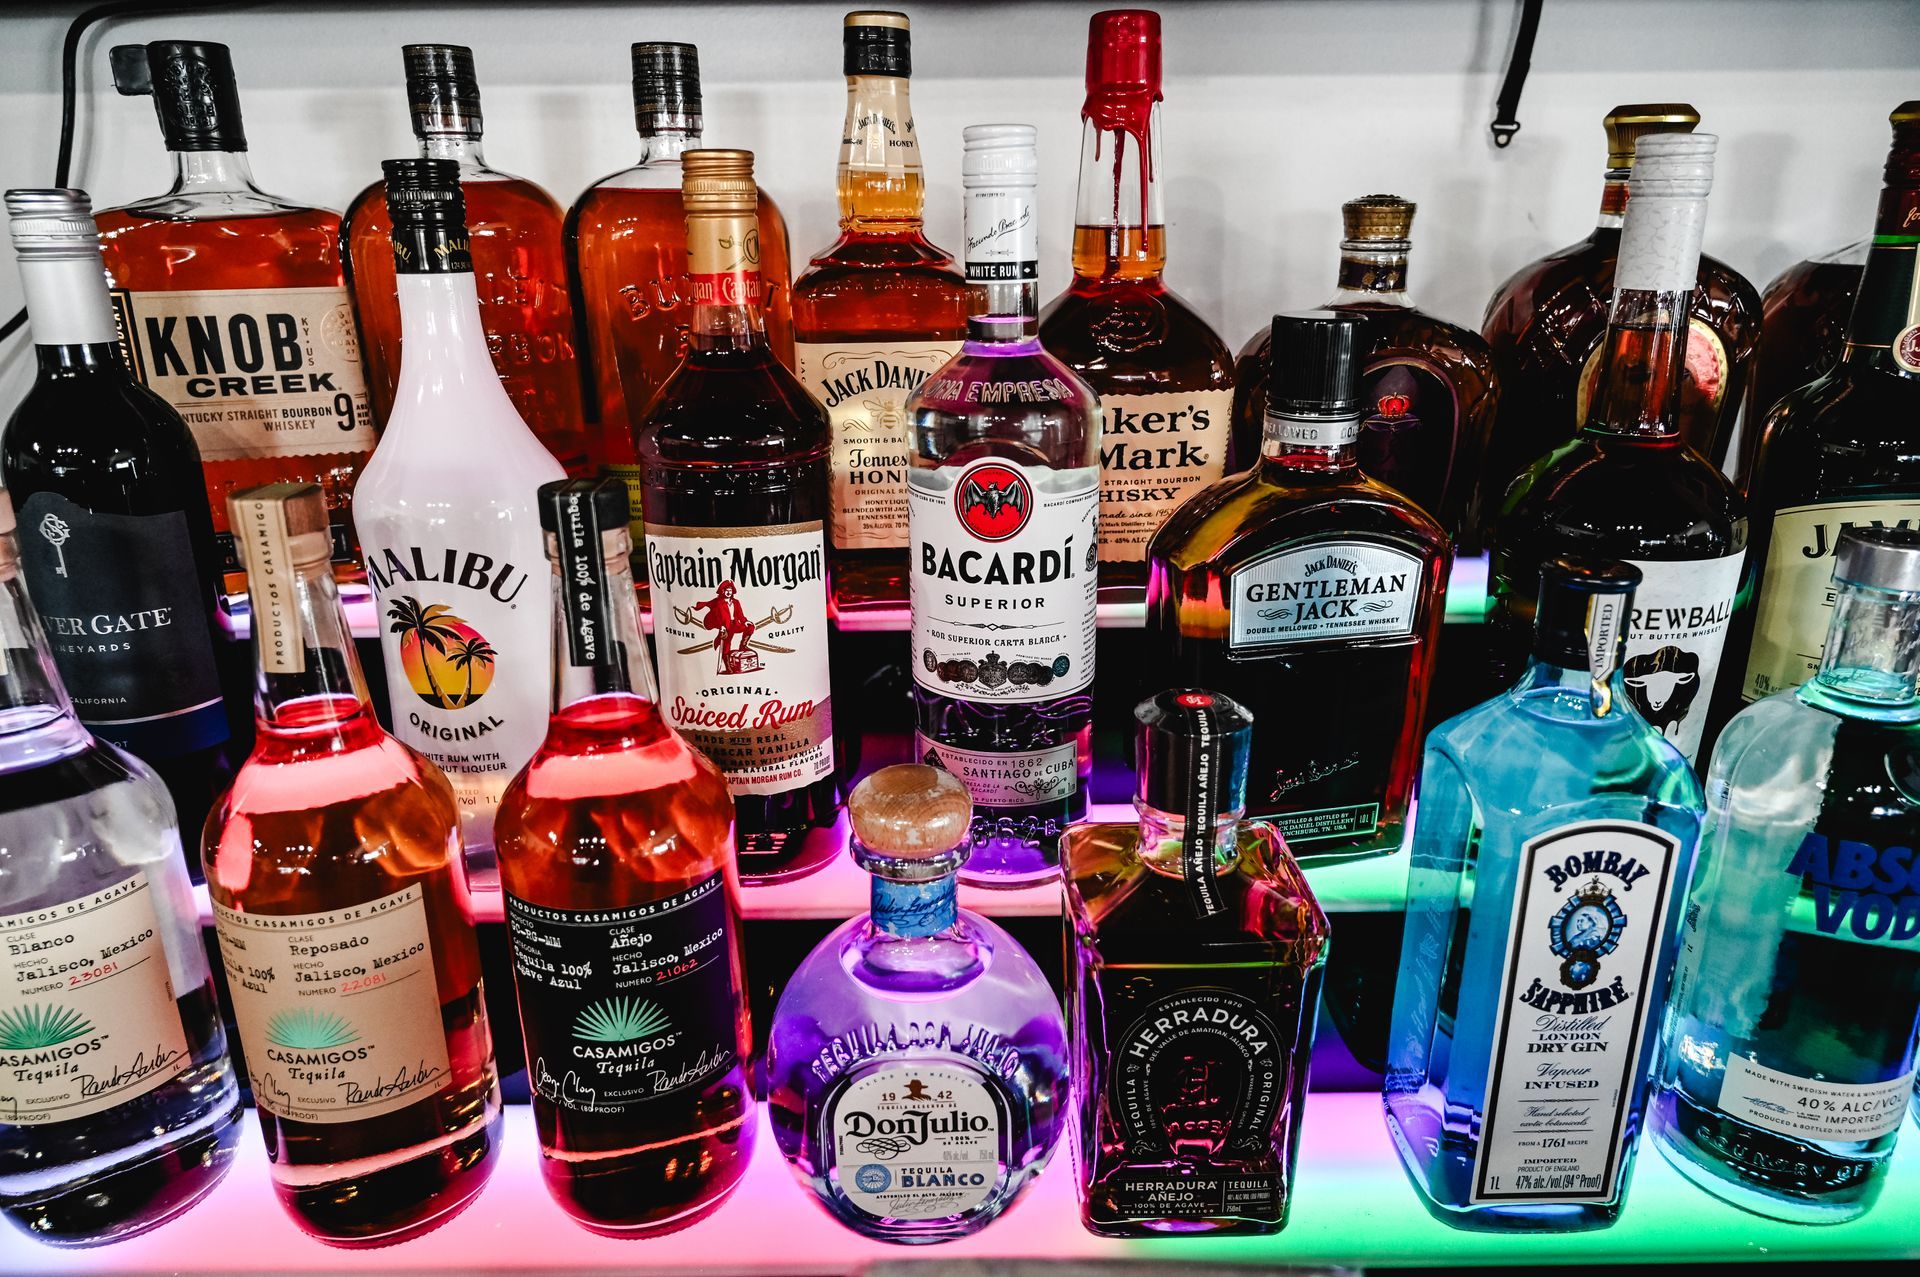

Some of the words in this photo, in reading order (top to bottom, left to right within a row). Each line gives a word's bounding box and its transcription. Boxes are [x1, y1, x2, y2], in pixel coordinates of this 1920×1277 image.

[889, 139, 914, 148] HONEY
[969, 265, 996, 278] WHITE
[999, 264, 1020, 277] RUM
[145, 313, 303, 376] KNOB
[186, 372, 337, 398] CREEK
[821, 367, 873, 408] JACK
[875, 361, 931, 392] DANI
[965, 377, 1074, 403] EMPRESA
[181, 411, 224, 424] NTUCKY
[227, 409, 278, 421] STRAIGHT
[282, 406, 332, 419] BOURBON
[334, 393, 355, 432] 9
[1102, 404, 1210, 434] ker's
[263, 419, 316, 432] WHISKEY
[843, 437, 881, 445] SMOOTH
[849, 448, 907, 468] Tennes
[1100, 440, 1207, 471] Mark
[1104, 478, 1152, 487] STRAIGHT
[1156, 475, 1201, 485] BOURBON
[648, 541, 722, 592] Captain
[722, 545, 821, 590] Morgan
[922, 534, 1074, 585] BACARDÍ
[1304, 557, 1326, 578] JACK
[368, 546, 528, 604] MALIBU
[575, 555, 596, 586] 100%
[1246, 574, 1407, 603] GENTLEMAN
[579, 592, 592, 611] de
[945, 594, 1045, 610] SUPERIOR
[91, 607, 171, 635] GATE
[1293, 599, 1358, 625] JACK
[1630, 598, 1731, 630] REWBALL
[267, 583, 284, 665] PRODUCTOS
[665, 626, 695, 639] GENUINE
[768, 625, 805, 639] QUALITY
[1246, 626, 1275, 635] DOUBLE
[1278, 623, 1318, 633] MELLOWED
[1325, 619, 1367, 629] TENNESSEE
[1368, 616, 1400, 625] WHISKEY
[1649, 632, 1688, 640] BUTTER
[1692, 625, 1722, 638] WHISKEY
[580, 617, 595, 661] Agave
[947, 633, 991, 646] SUPERIOR
[994, 638, 1025, 647] CARTA
[1028, 634, 1061, 646] BLANCA
[1595, 603, 1613, 668] IMPORTED
[701, 686, 771, 698] ORIGINAL
[671, 695, 749, 729] Spiced
[752, 699, 814, 730] Rum
[409, 711, 504, 741] ORIGINAL
[756, 733, 787, 744] REAL
[758, 737, 810, 755] VANILLA
[447, 753, 470, 763] RUM
[472, 751, 500, 762] WITH
[743, 763, 786, 774] NATURAL
[789, 752, 823, 768] FLAVORS
[941, 751, 994, 766] ESTABLECIDO
[1011, 757, 1042, 769] 1862
[461, 762, 507, 774] LIQUEUR
[963, 766, 1031, 779] SANTIAGO
[1045, 758, 1074, 775] CUBA
[1197, 753, 1210, 788] AÑEJO
[751, 774, 778, 784] MORGAN
[779, 772, 791, 781] RUM
[1197, 791, 1208, 834] TEQUILA
[1193, 838, 1204, 872] AÑEJO
[1544, 850, 1650, 892] BOMBAY
[67, 902, 85, 914] DE
[94, 880, 137, 905] AGAVE
[509, 896, 567, 922] PRODUCTOS
[575, 905, 655, 923] CASAMIGOS
[662, 898, 678, 910] DE
[684, 878, 716, 901] AGAVE
[1196, 876, 1216, 916] TEQUILA
[255, 916, 335, 928] CASAMIGOS
[344, 910, 361, 920] DE
[370, 892, 412, 913] AGAVE
[6, 932, 36, 943] CLASE
[288, 935, 314, 943] CLASE
[609, 926, 635, 936] CLASE
[610, 932, 652, 949] Añejo
[8, 934, 75, 956] Blanco
[289, 934, 369, 957] Reposado
[613, 953, 679, 976] Jalisco,
[684, 927, 723, 957] Mexico
[13, 957, 48, 969] HECHO
[17, 958, 95, 982] Jalisco,
[100, 928, 153, 960] Mexico
[295, 965, 367, 983] Jalisco,
[373, 941, 424, 970] Mexico
[513, 945, 555, 973] Tequila
[561, 961, 593, 979] 100%
[612, 951, 643, 962] HECHO
[293, 961, 324, 970] HECHO
[516, 960, 543, 983] Agave
[549, 977, 582, 990] Azul
[615, 976, 653, 989] NUMERO
[655, 958, 699, 982] 21062
[21, 981, 64, 997] NUMERO
[68, 961, 118, 986] 23081
[298, 986, 336, 997] NUMERO
[341, 972, 386, 993] 22081
[1158, 996, 1219, 1012] ESTABLECIDO
[1519, 975, 1630, 1014] SAPPHIRE
[1129, 1007, 1268, 1058] HERRADURA
[1532, 1014, 1611, 1032] Distilled
[1539, 1032, 1600, 1041] LONDON
[0, 1038, 102, 1067] ASAMIGOS
[266, 1047, 368, 1065] CASAMIGOS
[572, 1034, 676, 1059] CASAMIGOS
[1527, 1042, 1568, 1053] DRY
[1570, 1041, 1609, 1053] GIN
[13, 1062, 80, 1084] Tequila
[288, 1067, 346, 1085] Tequila
[596, 1057, 655, 1078] Tequila
[1536, 1062, 1591, 1080] Vapour
[1524, 1080, 1599, 1090] INFUSED
[1744, 1068, 1767, 1081] MADE
[1769, 1077, 1791, 1088] WITH
[1792, 1084, 1829, 1096] SWEDISH
[26, 1093, 70, 1105] EXCLUSIVO
[297, 1096, 336, 1104] EXCLUSIVO
[603, 1087, 645, 1097] EXCLUSIVO
[881, 1092, 896, 1102] 19
[937, 1090, 953, 1100] 42
[1249, 1071, 1273, 1131] ORIGINAL
[1126, 1078, 1147, 1136] TEQUILA
[1524, 1106, 1553, 1118] Hand
[1553, 1106, 1590, 1117] selected
[1797, 1096, 1835, 1112] 40%
[1544, 1117, 1589, 1127] botanicals
[1749, 1109, 1791, 1127] PRODUCED
[1800, 1123, 1833, 1134] BOTTLED
[1825, 1113, 1882, 1125] IMPORTED
[1542, 1138, 1565, 1148] 1761
[901, 1166, 953, 1175] TEQUILA
[1553, 1164, 1580, 1172] ENGLAND
[901, 1173, 985, 1188] BLANCO
[1125, 1180, 1216, 1192] HERRADURA
[1228, 1180, 1269, 1189] TEQUILA
[1515, 1175, 1532, 1189] 47%
[1147, 1189, 1194, 1202] AÑEJO
[1174, 1201, 1205, 1209] AGAVE
